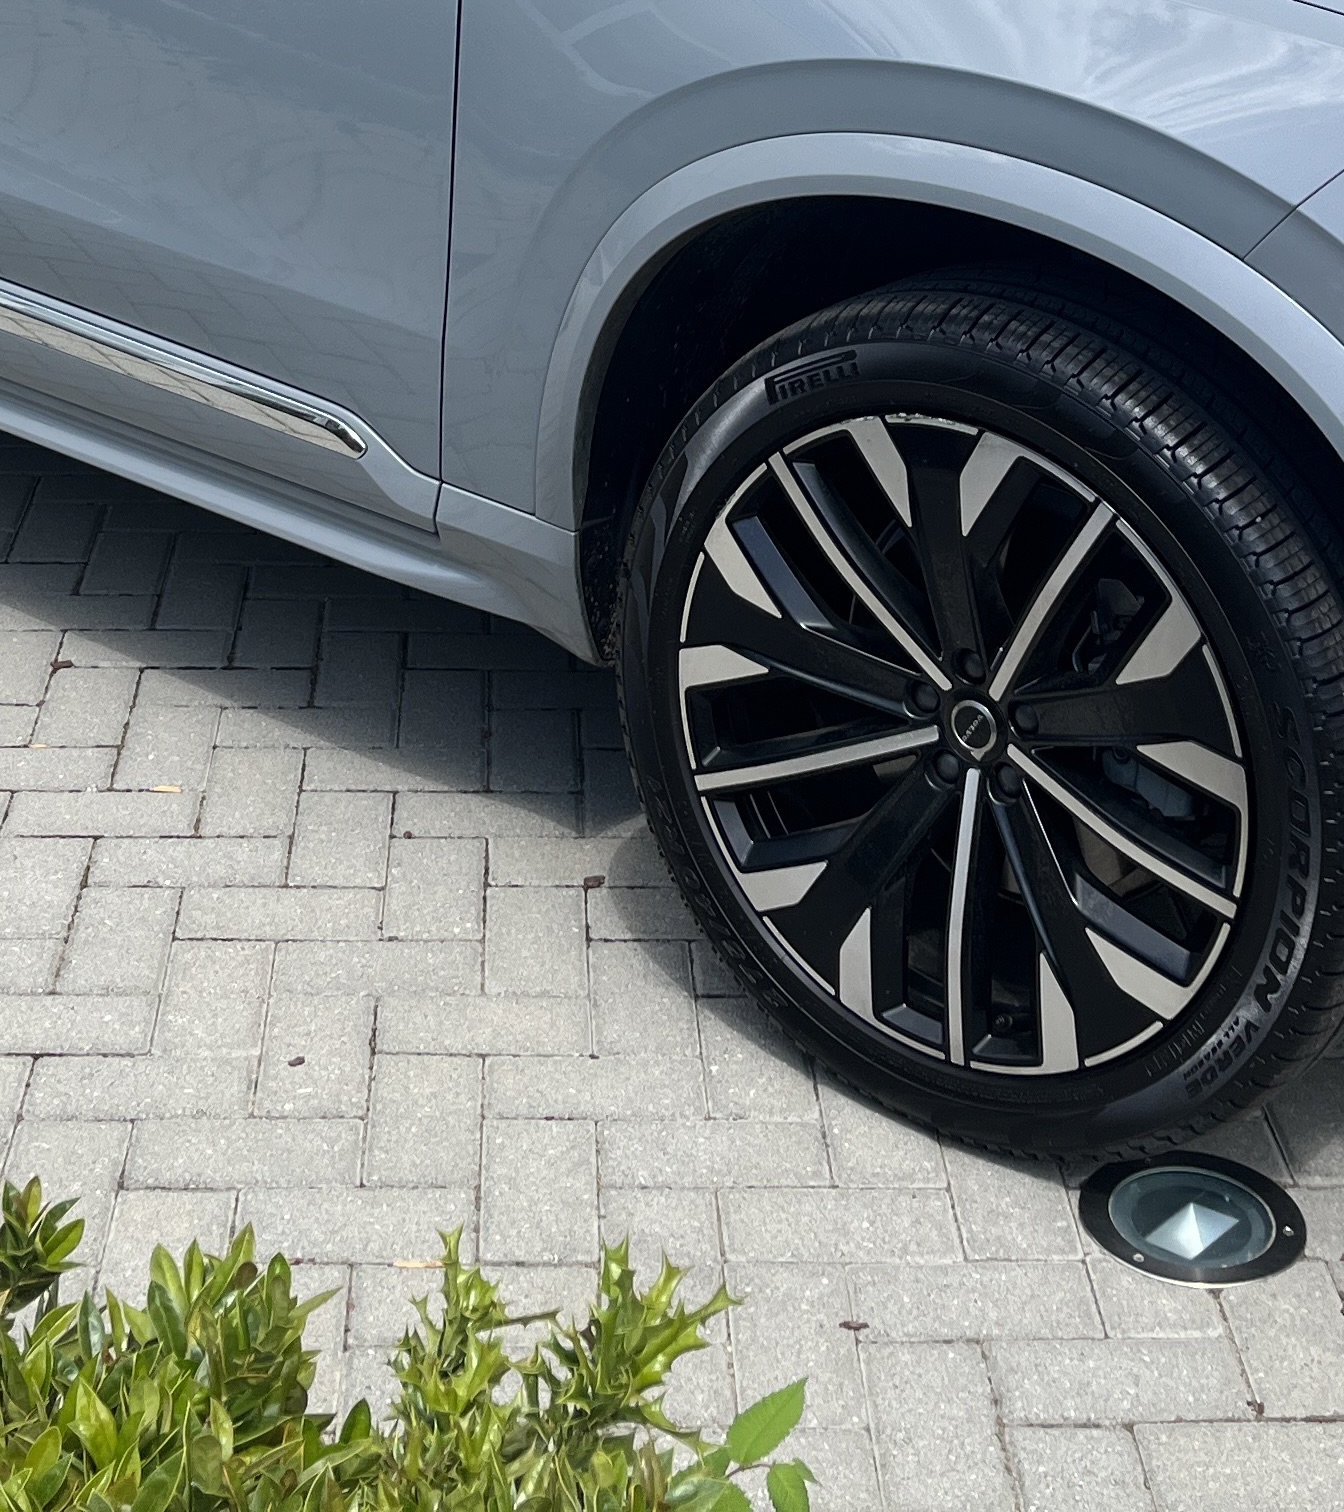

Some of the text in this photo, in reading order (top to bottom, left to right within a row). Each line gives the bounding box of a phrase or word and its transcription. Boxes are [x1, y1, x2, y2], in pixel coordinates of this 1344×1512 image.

[764, 349, 860, 406] PIRELLI
[962, 714, 984, 742] VOLVO
[1253, 701, 1312, 1014] SCORPION
[1185, 1019, 1260, 1099] VERDE
